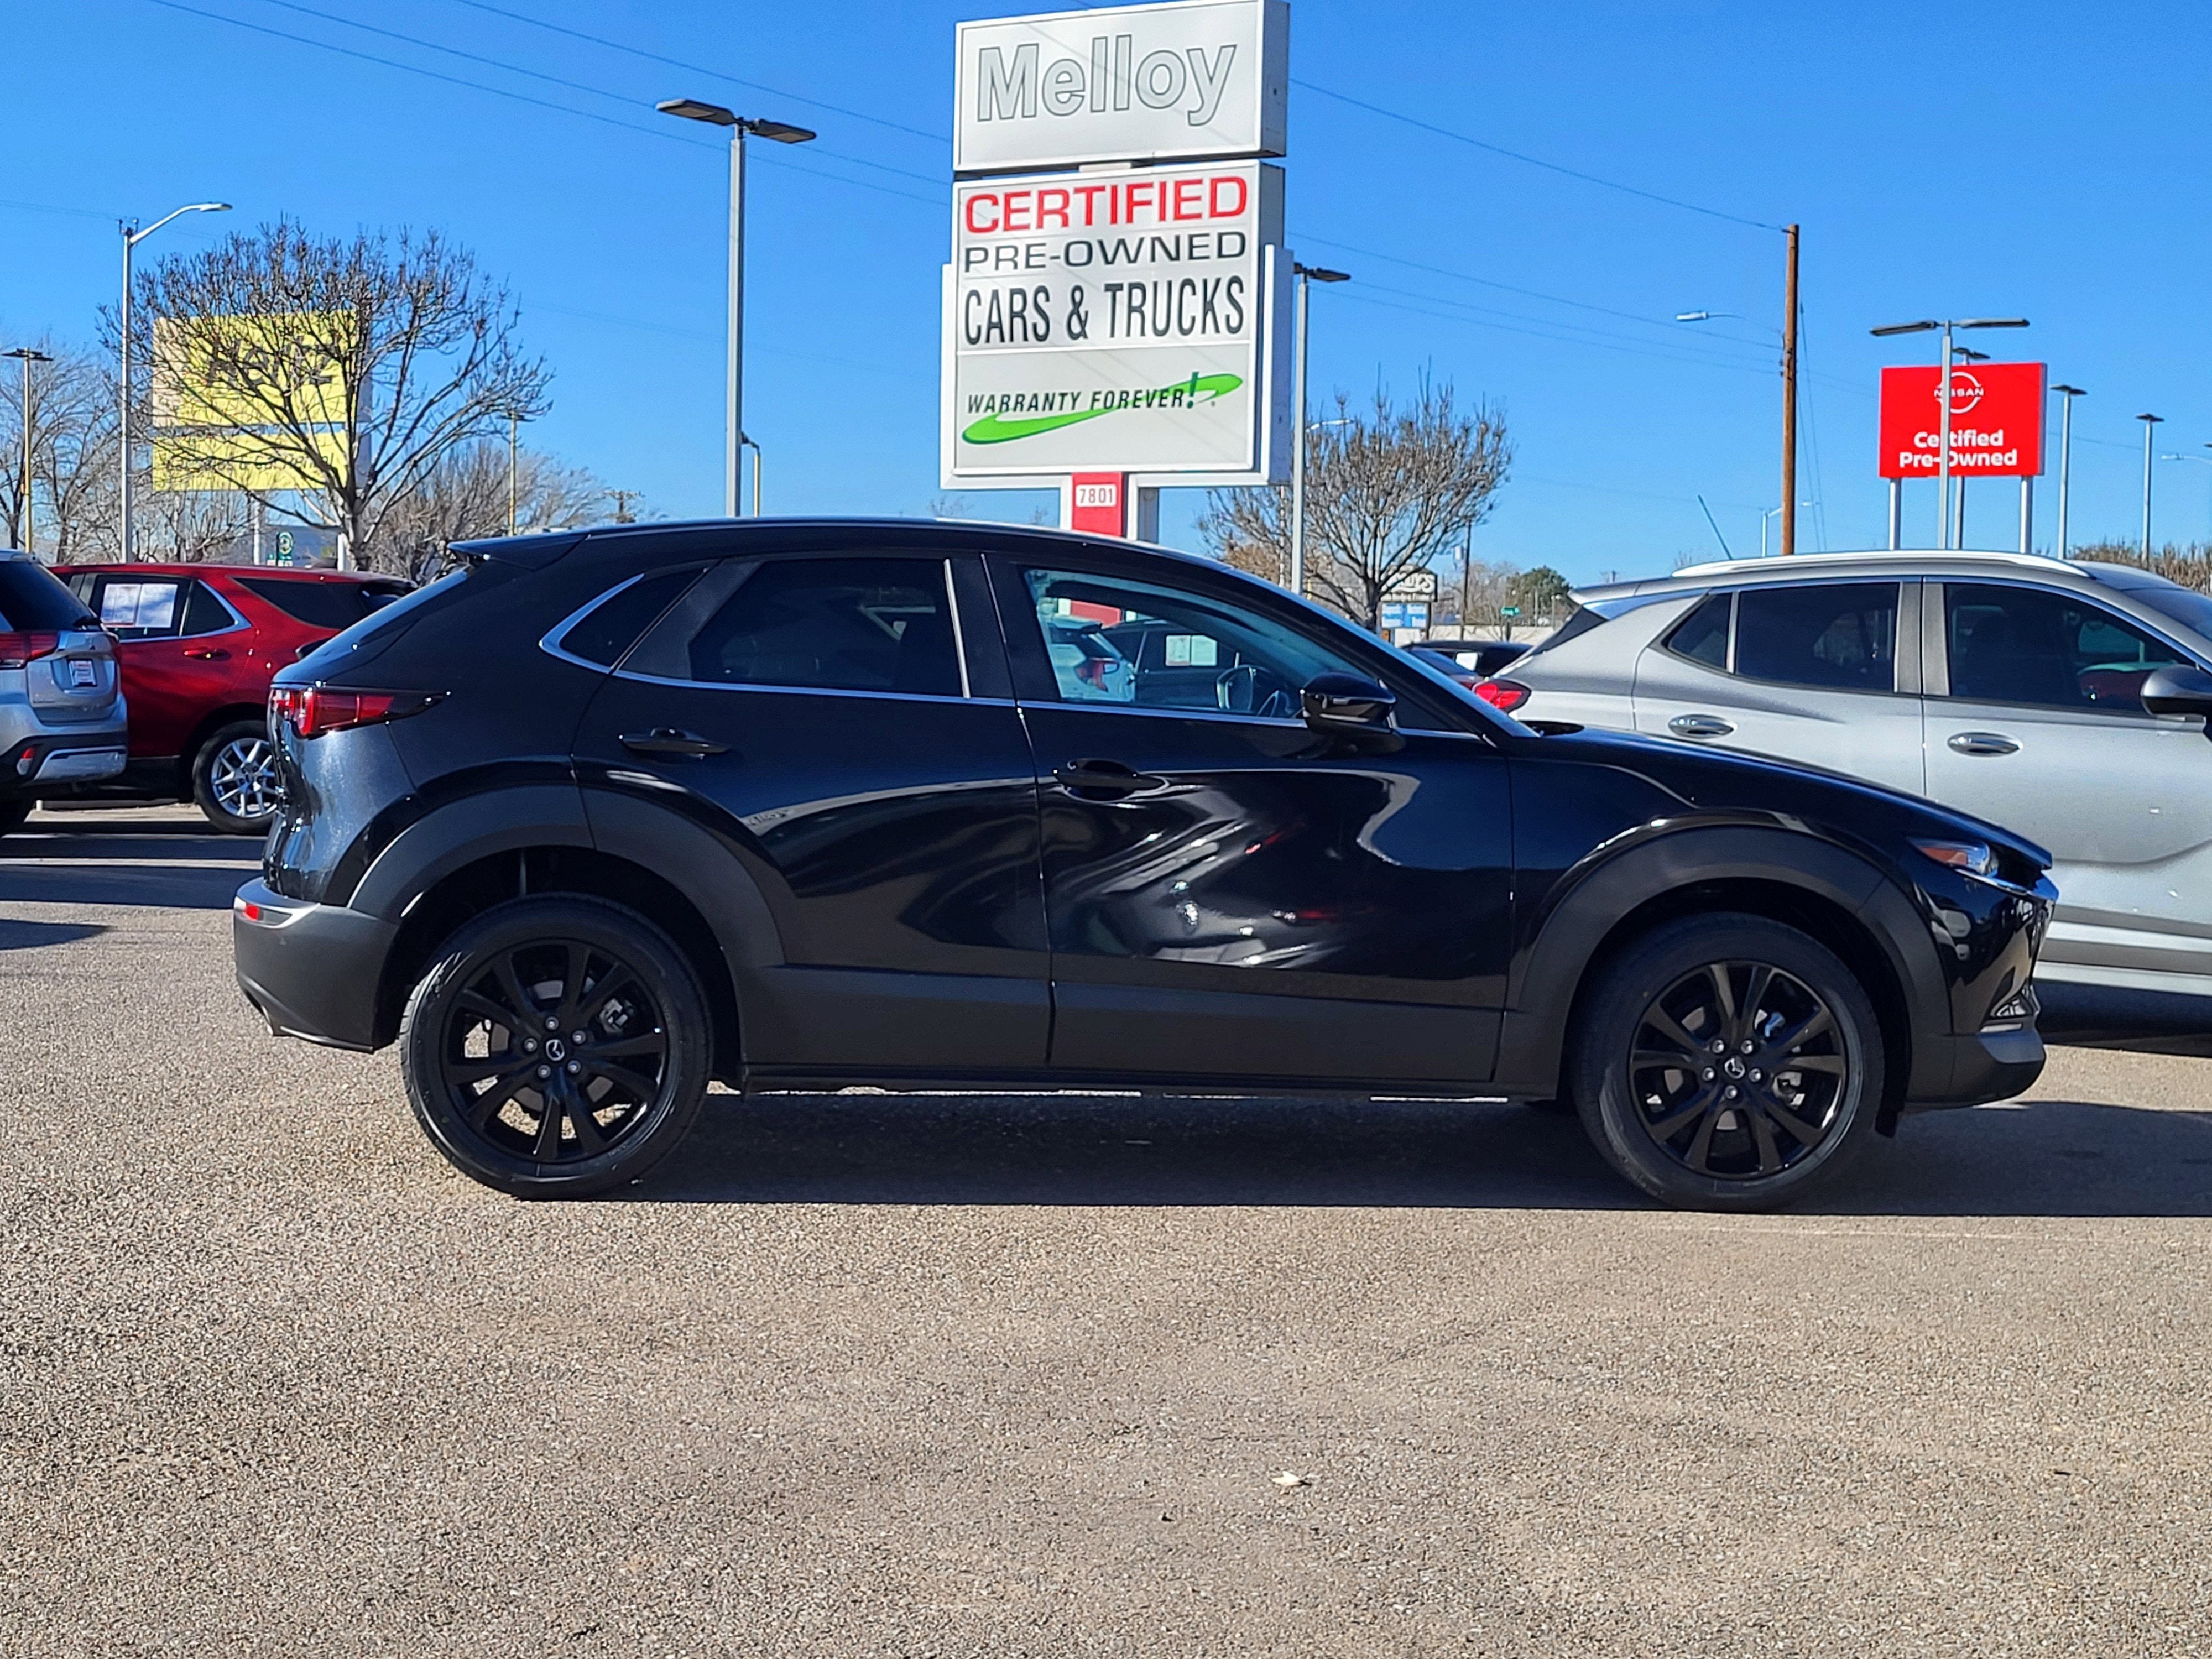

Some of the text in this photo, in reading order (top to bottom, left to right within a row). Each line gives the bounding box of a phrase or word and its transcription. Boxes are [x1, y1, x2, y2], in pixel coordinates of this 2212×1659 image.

[977, 34, 1237, 127] Melloy
[966, 176, 1247, 233] CERTIFIED
[964, 231, 1246, 273] PRE-OWNED
[964, 275, 1244, 345] CARS & TRUCKS
[967, 371, 1199, 413] WARRANTY FOREVER!
[1934, 387, 1984, 397] NSSAN
[1914, 429, 2004, 448] Cetified
[1079, 488, 1113, 504] 7801
